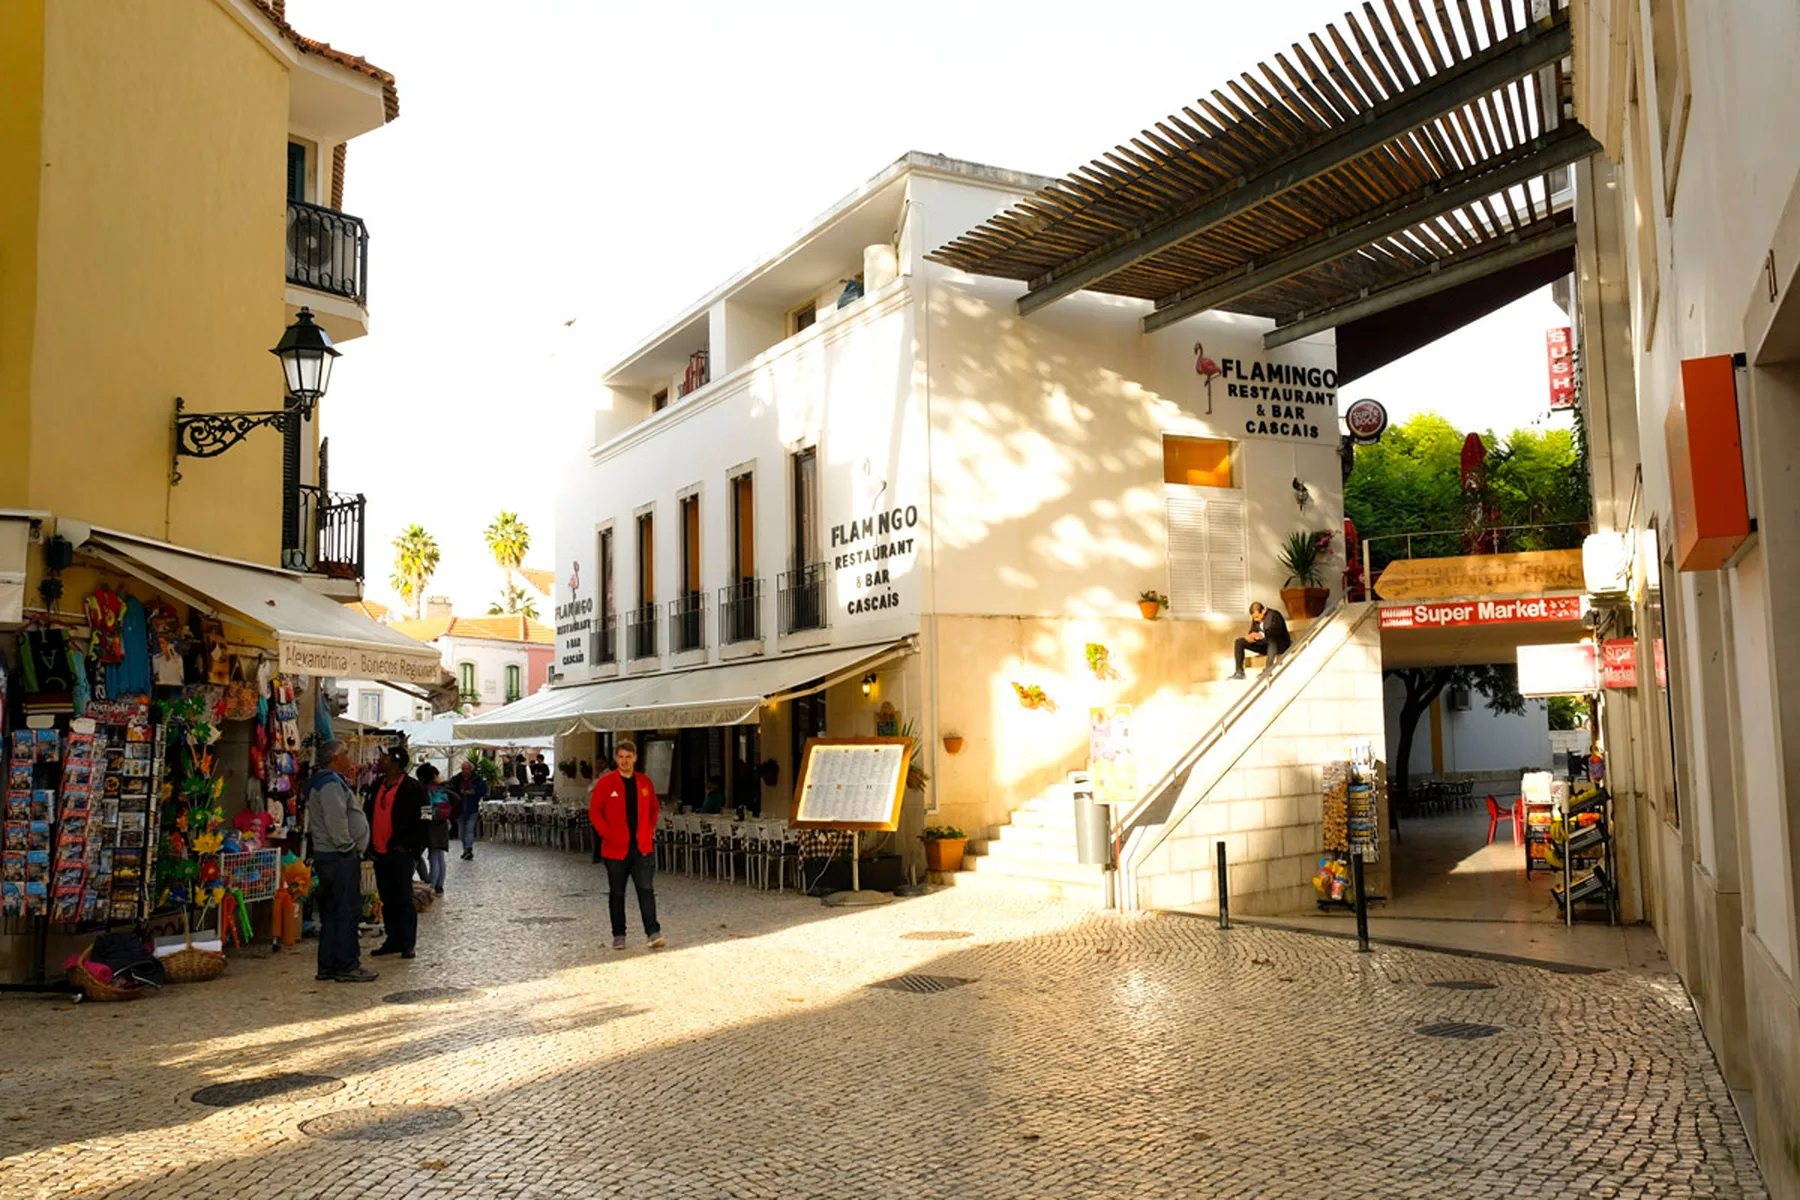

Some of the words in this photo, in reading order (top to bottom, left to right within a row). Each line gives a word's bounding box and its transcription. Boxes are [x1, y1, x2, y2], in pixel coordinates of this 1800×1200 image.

[1221, 358, 1337, 389] FLAMINGO
[1227, 383, 1336, 406] RESTAURANT
[1256, 404, 1265, 417] &
[1271, 405, 1305, 420] BAR
[1245, 420, 1319, 439] CASCAIS
[831, 505, 917, 548] FLAMNGO
[835, 538, 914, 571] RESTAURANT
[865, 569, 890, 587] BAR
[1414, 605, 1474, 626] Super
[1478, 599, 1548, 621] Market
[285, 645, 348, 671] Alexandrina
